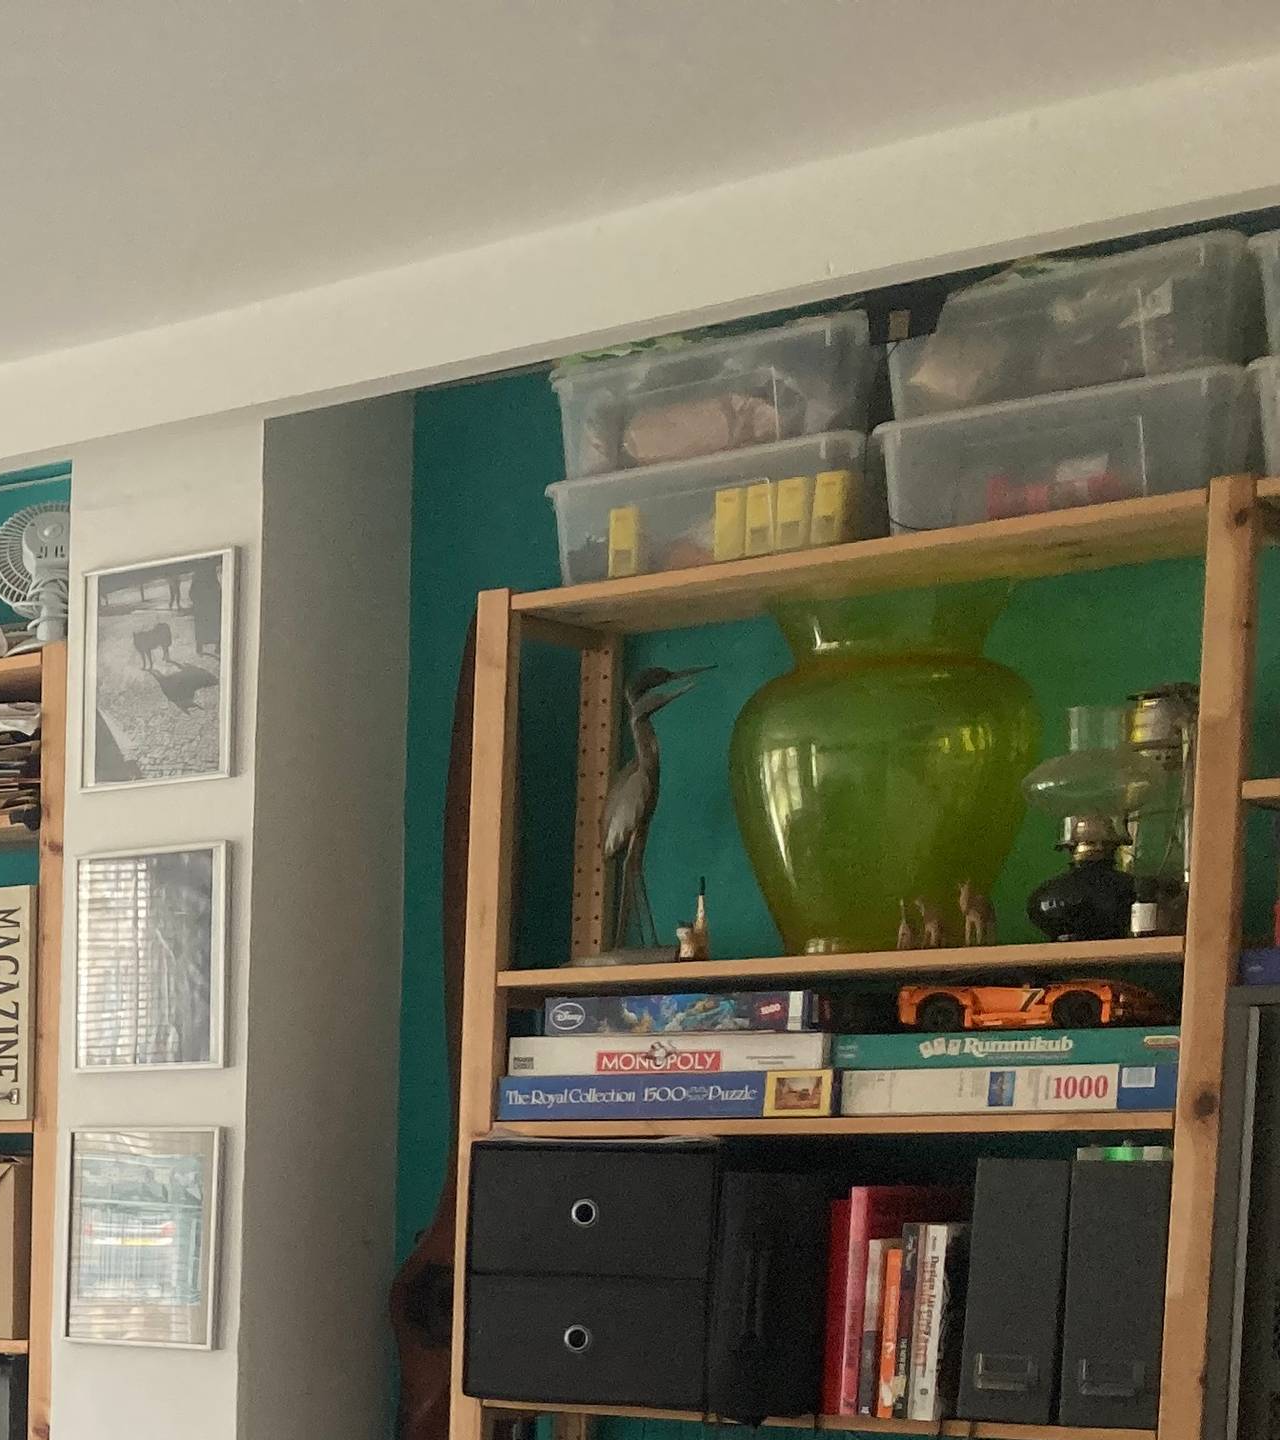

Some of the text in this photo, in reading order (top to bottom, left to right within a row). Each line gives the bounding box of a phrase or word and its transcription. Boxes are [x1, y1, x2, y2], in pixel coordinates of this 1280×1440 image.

[555, 1009, 583, 1024] Disney
[964, 1036, 1074, 1058] Rummikub
[601, 1051, 716, 1071] MONOPOLY
[506, 1085, 758, 1109] The Royal Collection 1500 Puzzle
[1053, 1075, 1109, 1099] 1000
